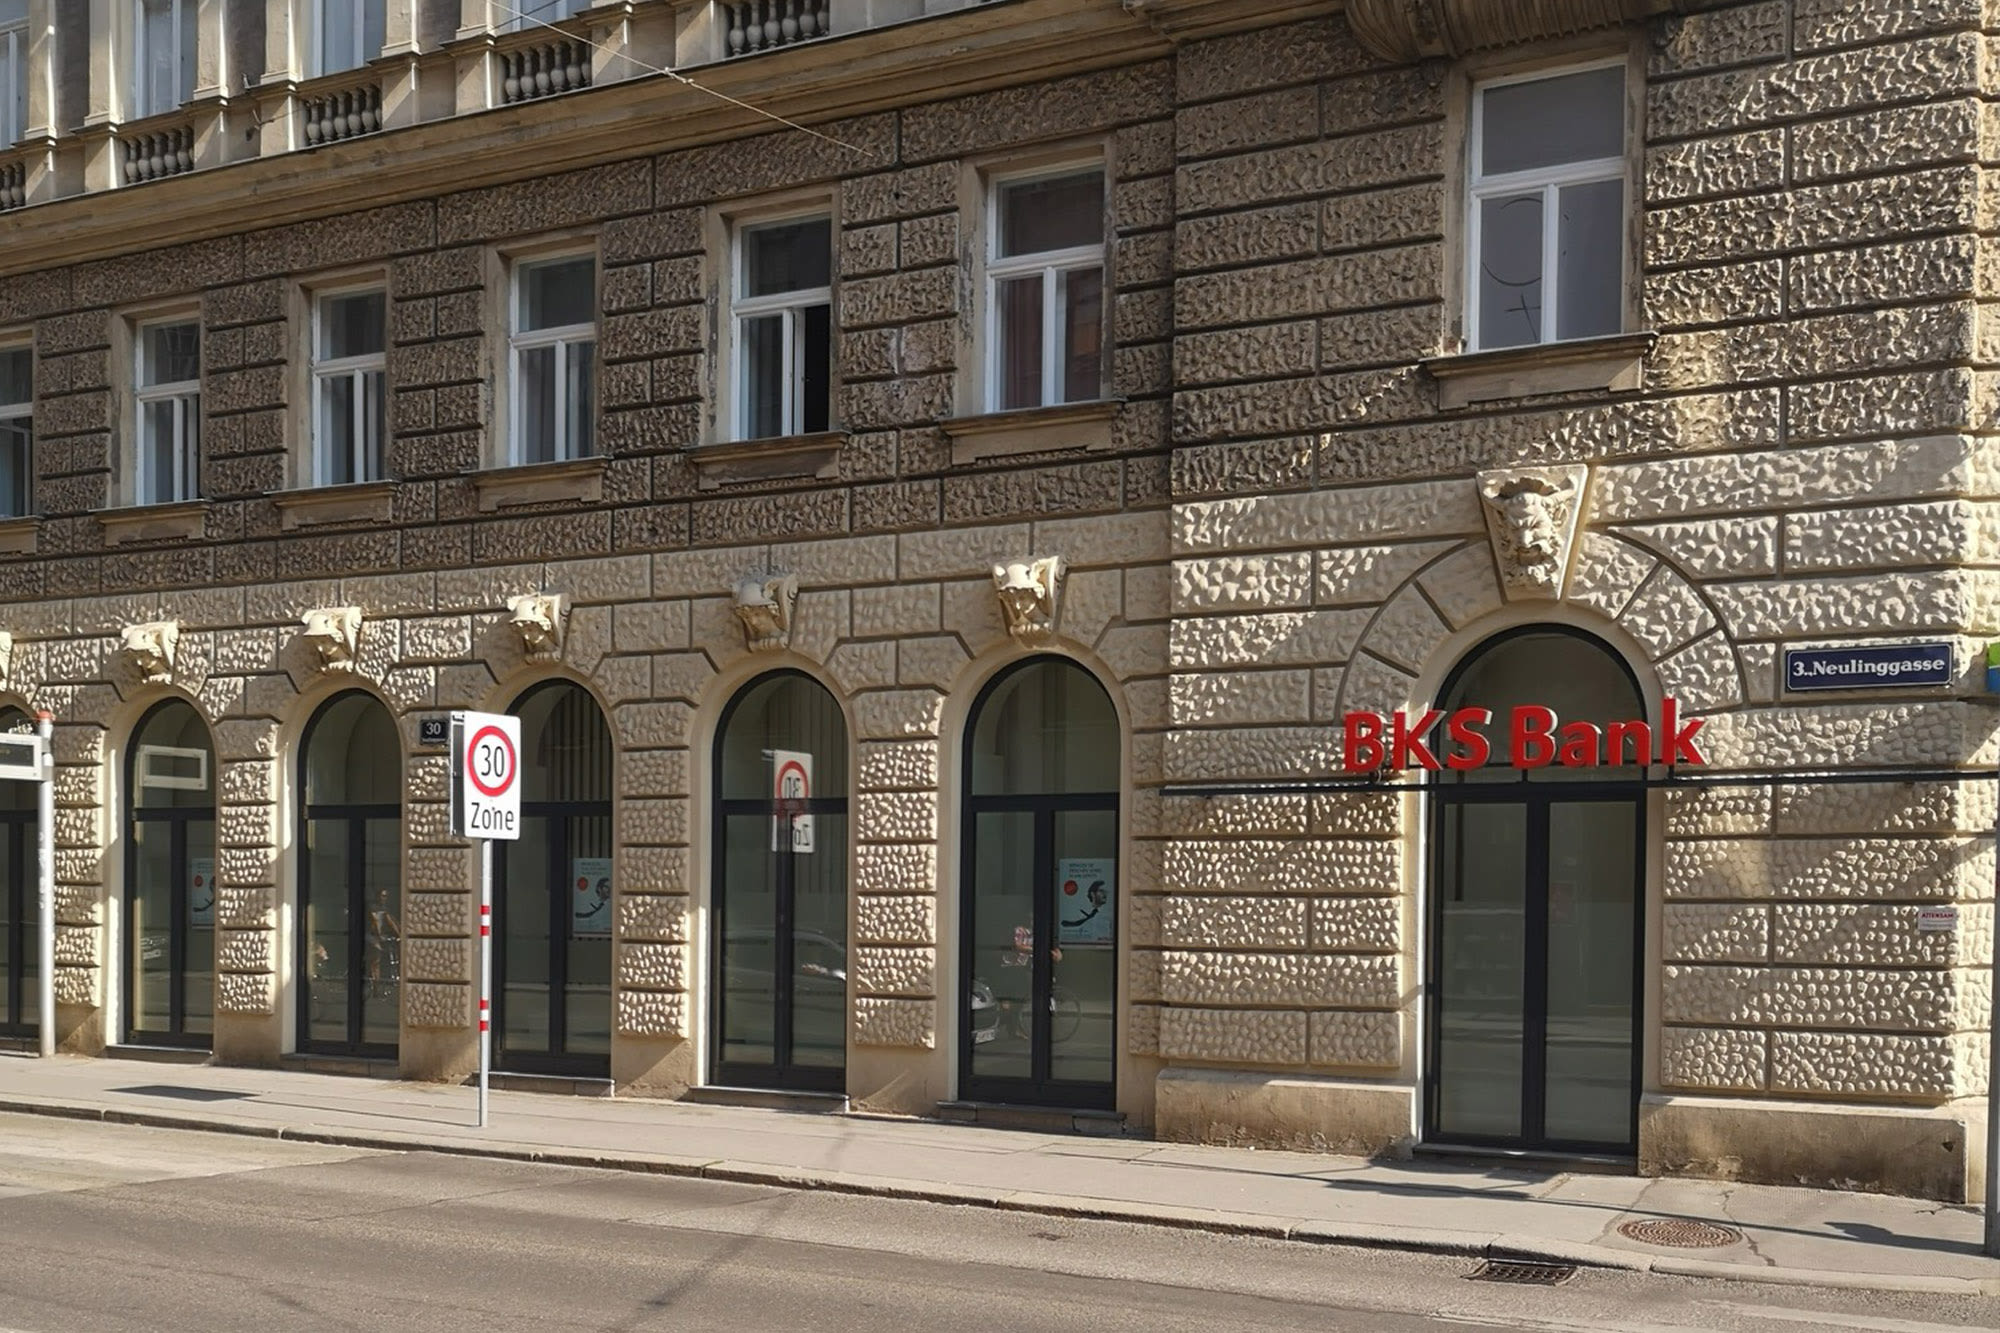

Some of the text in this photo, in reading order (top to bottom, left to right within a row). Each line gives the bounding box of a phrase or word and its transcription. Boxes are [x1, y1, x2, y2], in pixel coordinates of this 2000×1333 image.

[426, 722, 441, 735] 30
[1343, 697, 1708, 773] BKS Bank
[481, 744, 505, 778] 30
[471, 802, 514, 831] Zone
